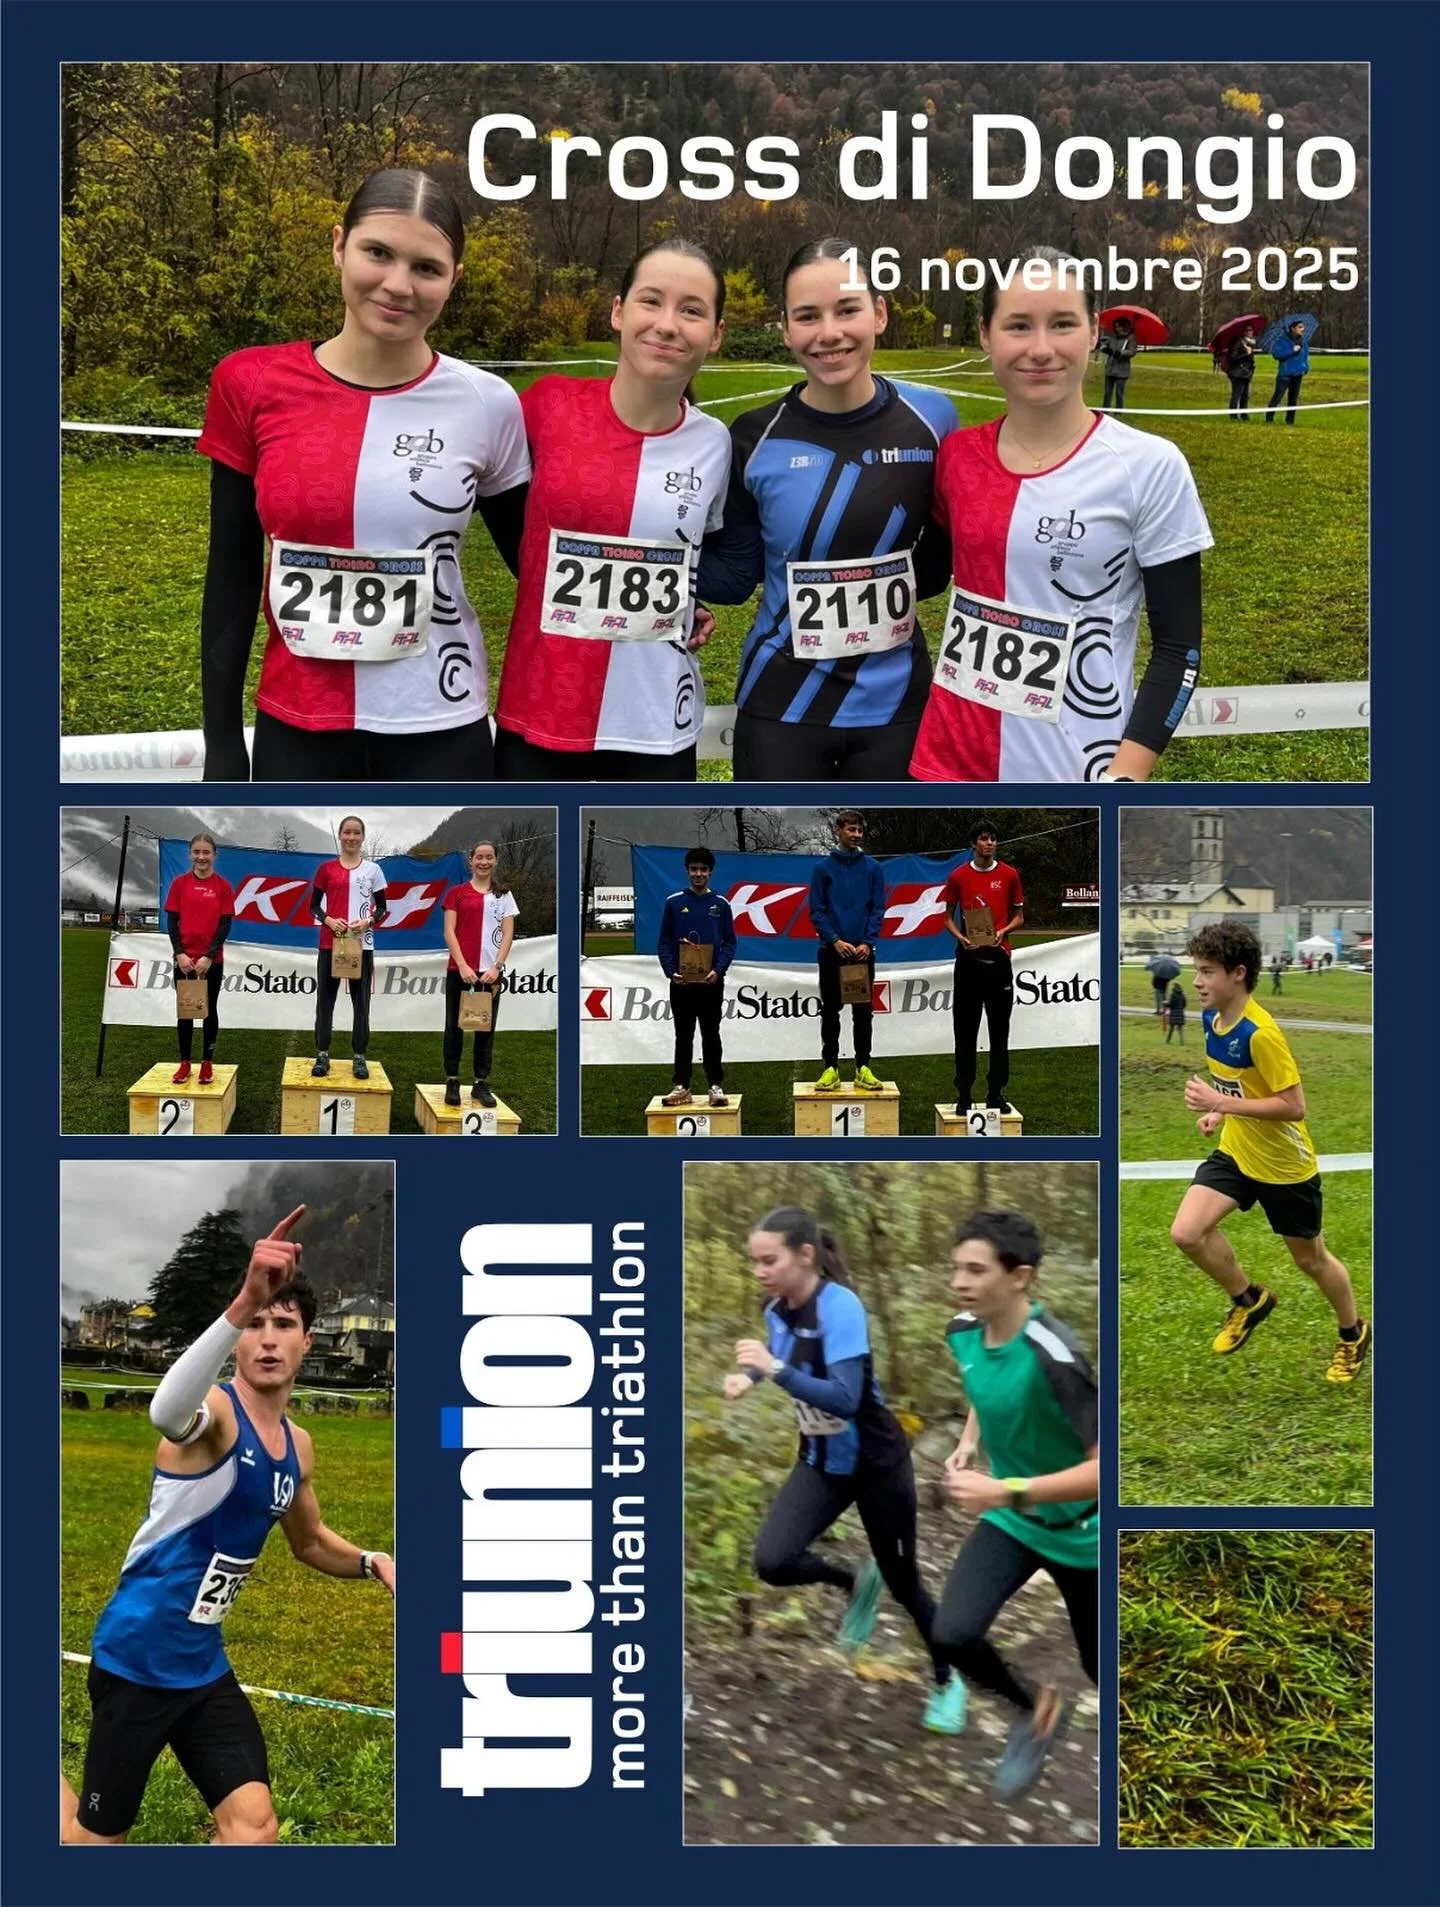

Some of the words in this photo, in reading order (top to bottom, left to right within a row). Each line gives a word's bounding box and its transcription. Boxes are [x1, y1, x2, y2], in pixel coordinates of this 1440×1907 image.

[881, 447, 933, 464] triunion
[279, 571, 417, 627] 2181
[552, 558, 680, 614] 2183
[796, 578, 910, 630] 2110
[944, 615, 1061, 691] 2182
[161, 1099, 180, 1135] 2
[323, 1098, 339, 1135] 1
[834, 1107, 849, 1136] 1
